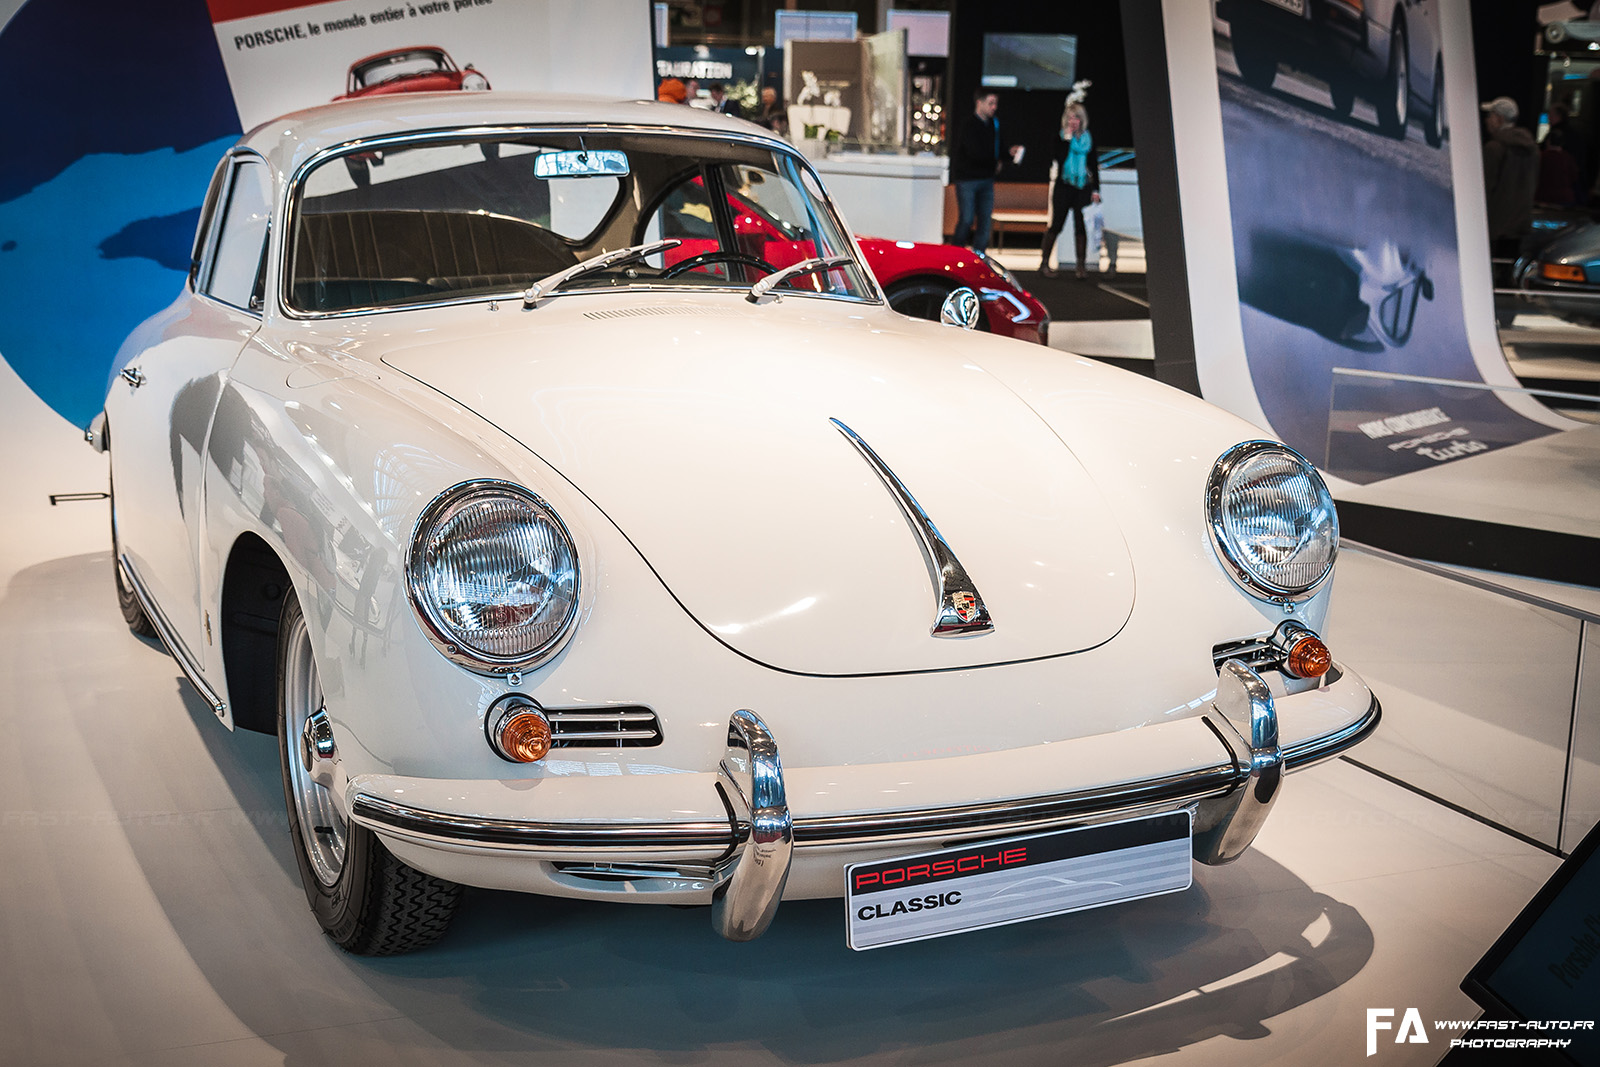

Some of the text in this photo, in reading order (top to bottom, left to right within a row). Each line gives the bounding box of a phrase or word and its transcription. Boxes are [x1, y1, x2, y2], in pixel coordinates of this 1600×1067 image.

[233, 23, 307, 51] PORSCHE,
[307, 21, 321, 36] le
[323, 13, 367, 33] monde
[369, 6, 405, 25] entier
[406, 1, 417, 18] à
[418, 1, 451, 16] votre
[856, 847, 1027, 889] PORSCHE
[857, 891, 962, 921] CLASSIC
